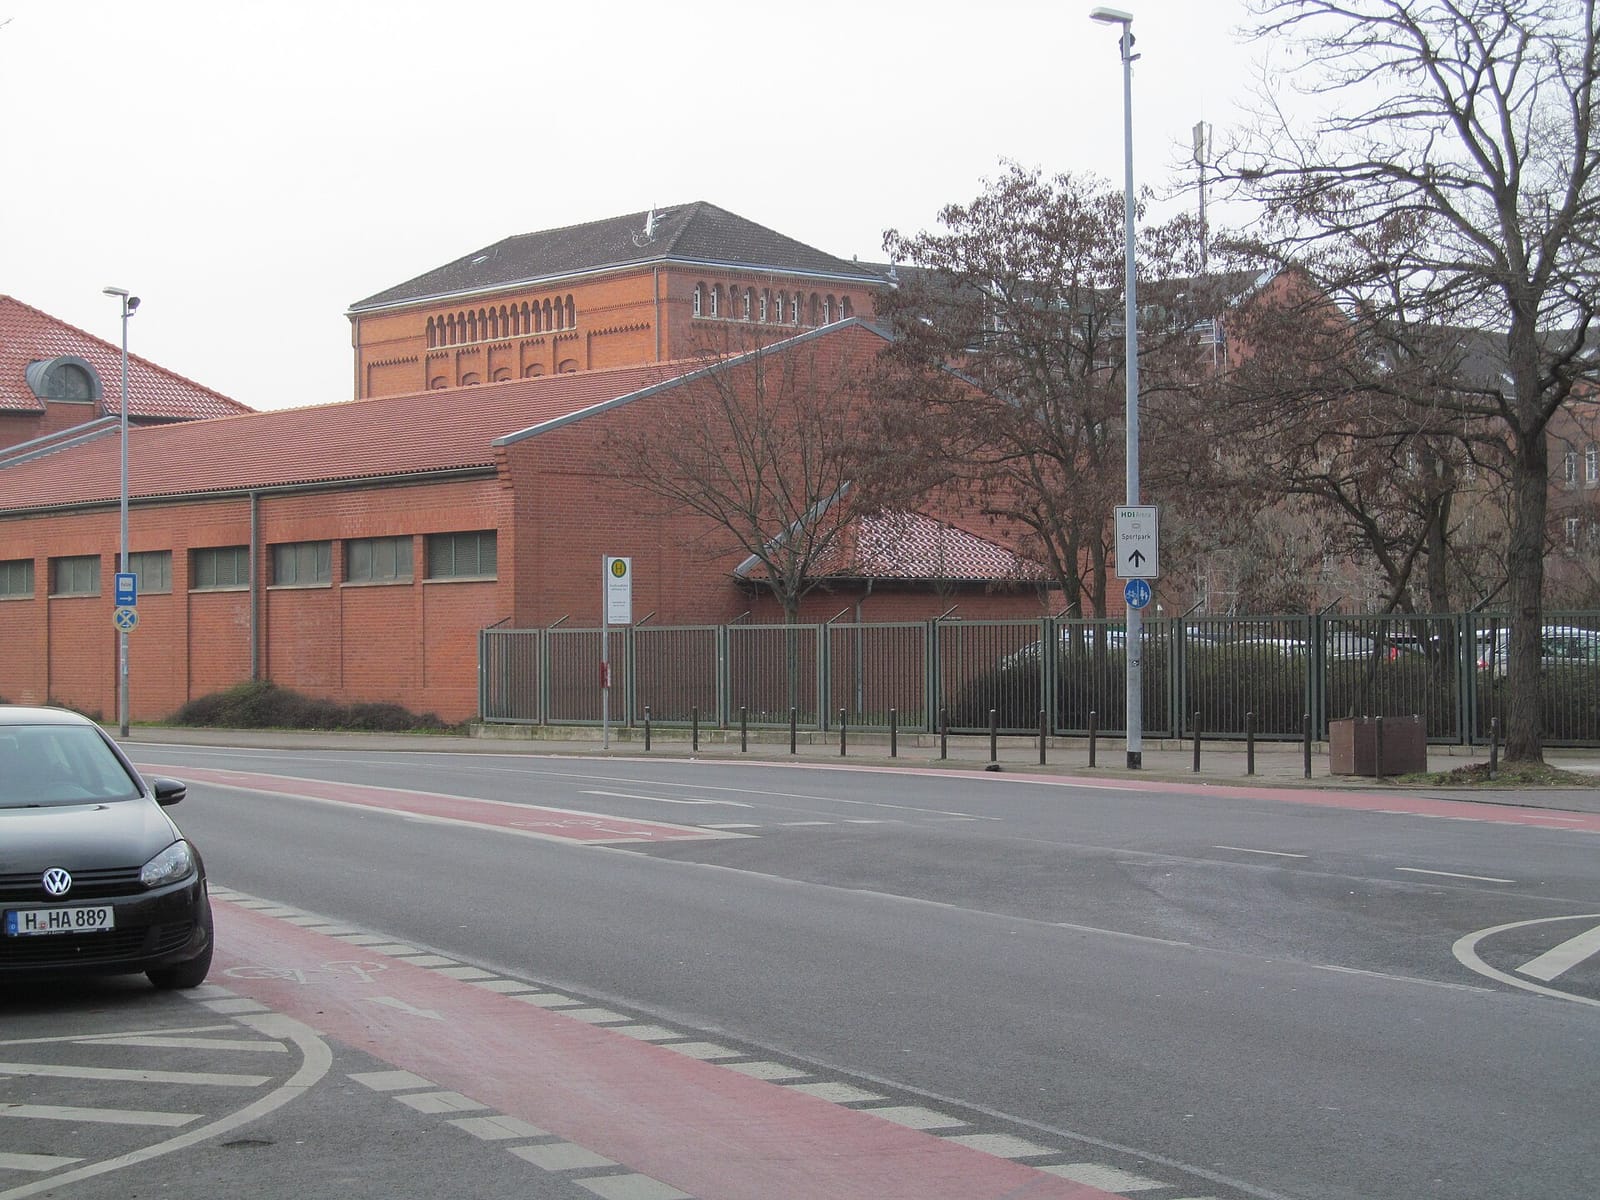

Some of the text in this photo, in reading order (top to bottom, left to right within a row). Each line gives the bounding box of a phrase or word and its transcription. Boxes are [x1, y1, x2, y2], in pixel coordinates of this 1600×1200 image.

[1121, 533, 1152, 541] Sportpark
[25, 908, 107, 930] H HA 889
